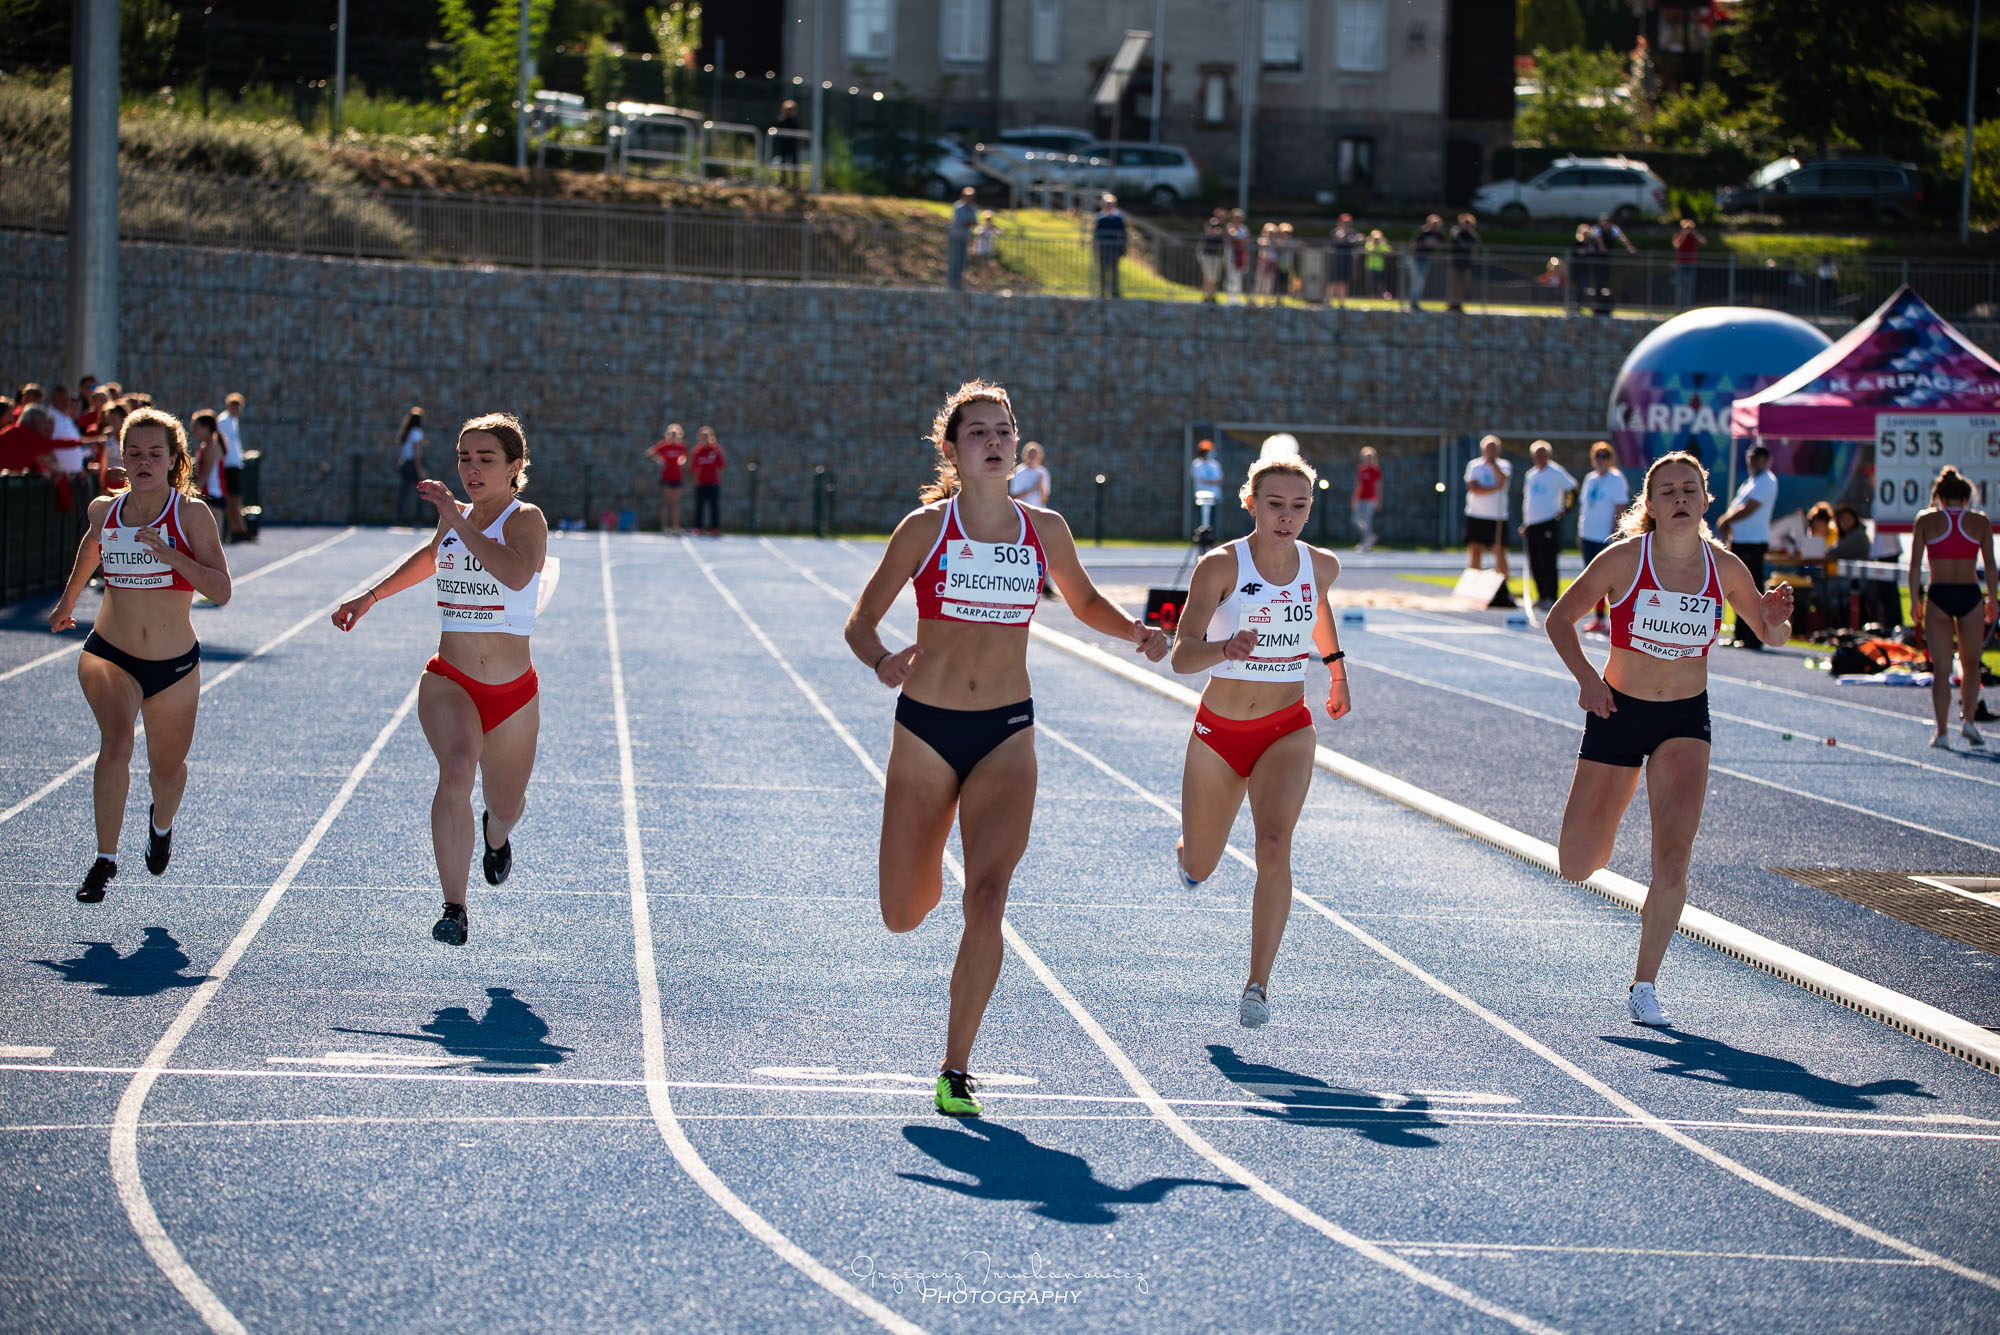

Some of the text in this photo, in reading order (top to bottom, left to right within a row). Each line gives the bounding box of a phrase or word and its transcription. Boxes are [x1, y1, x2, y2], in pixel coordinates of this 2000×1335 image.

[1613, 402, 1732, 434] KARPAC
[1880, 430, 1943, 457] 533
[103, 552, 160, 565] HETTLEROV
[464, 555, 488, 572] 10
[994, 546, 1030, 565] 503
[144, 577, 163, 585] 2020
[950, 573, 1035, 593] SPLECHTNOVA
[956, 606, 1022, 619] KARPACZ 2020
[1284, 605, 1313, 622] 105
[1680, 596, 1710, 614] 527
[443, 609, 493, 620] KARPACZ 2020
[1642, 618, 1707, 637] HULKOVA
[1257, 633, 1300, 647] ZIMNA
[1643, 641, 1679, 657] KARPACZ
[1245, 661, 1302, 672] KARPACZ 2020
